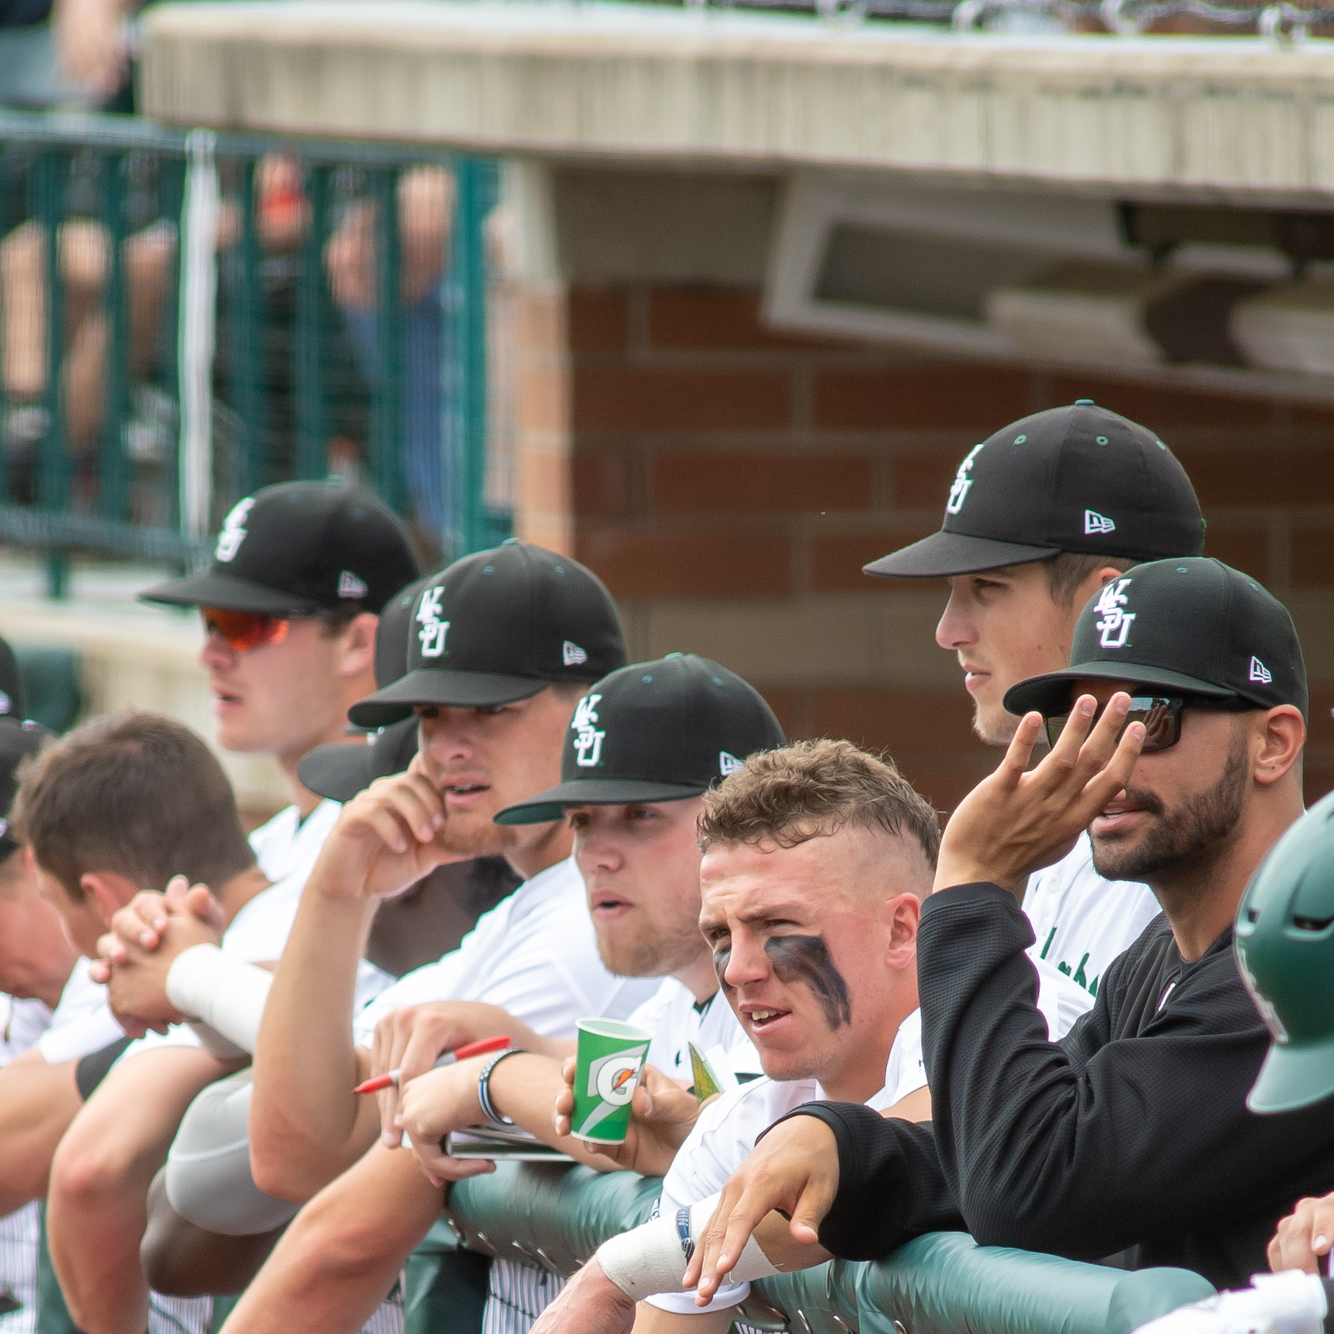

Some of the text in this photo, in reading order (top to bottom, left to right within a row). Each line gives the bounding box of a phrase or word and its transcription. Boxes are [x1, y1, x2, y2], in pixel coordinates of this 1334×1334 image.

[416, 586, 450, 657] WSU
[1094, 579, 1136, 648] WSU
[571, 694, 606, 767] WSU
[596, 1055, 642, 1107] G
